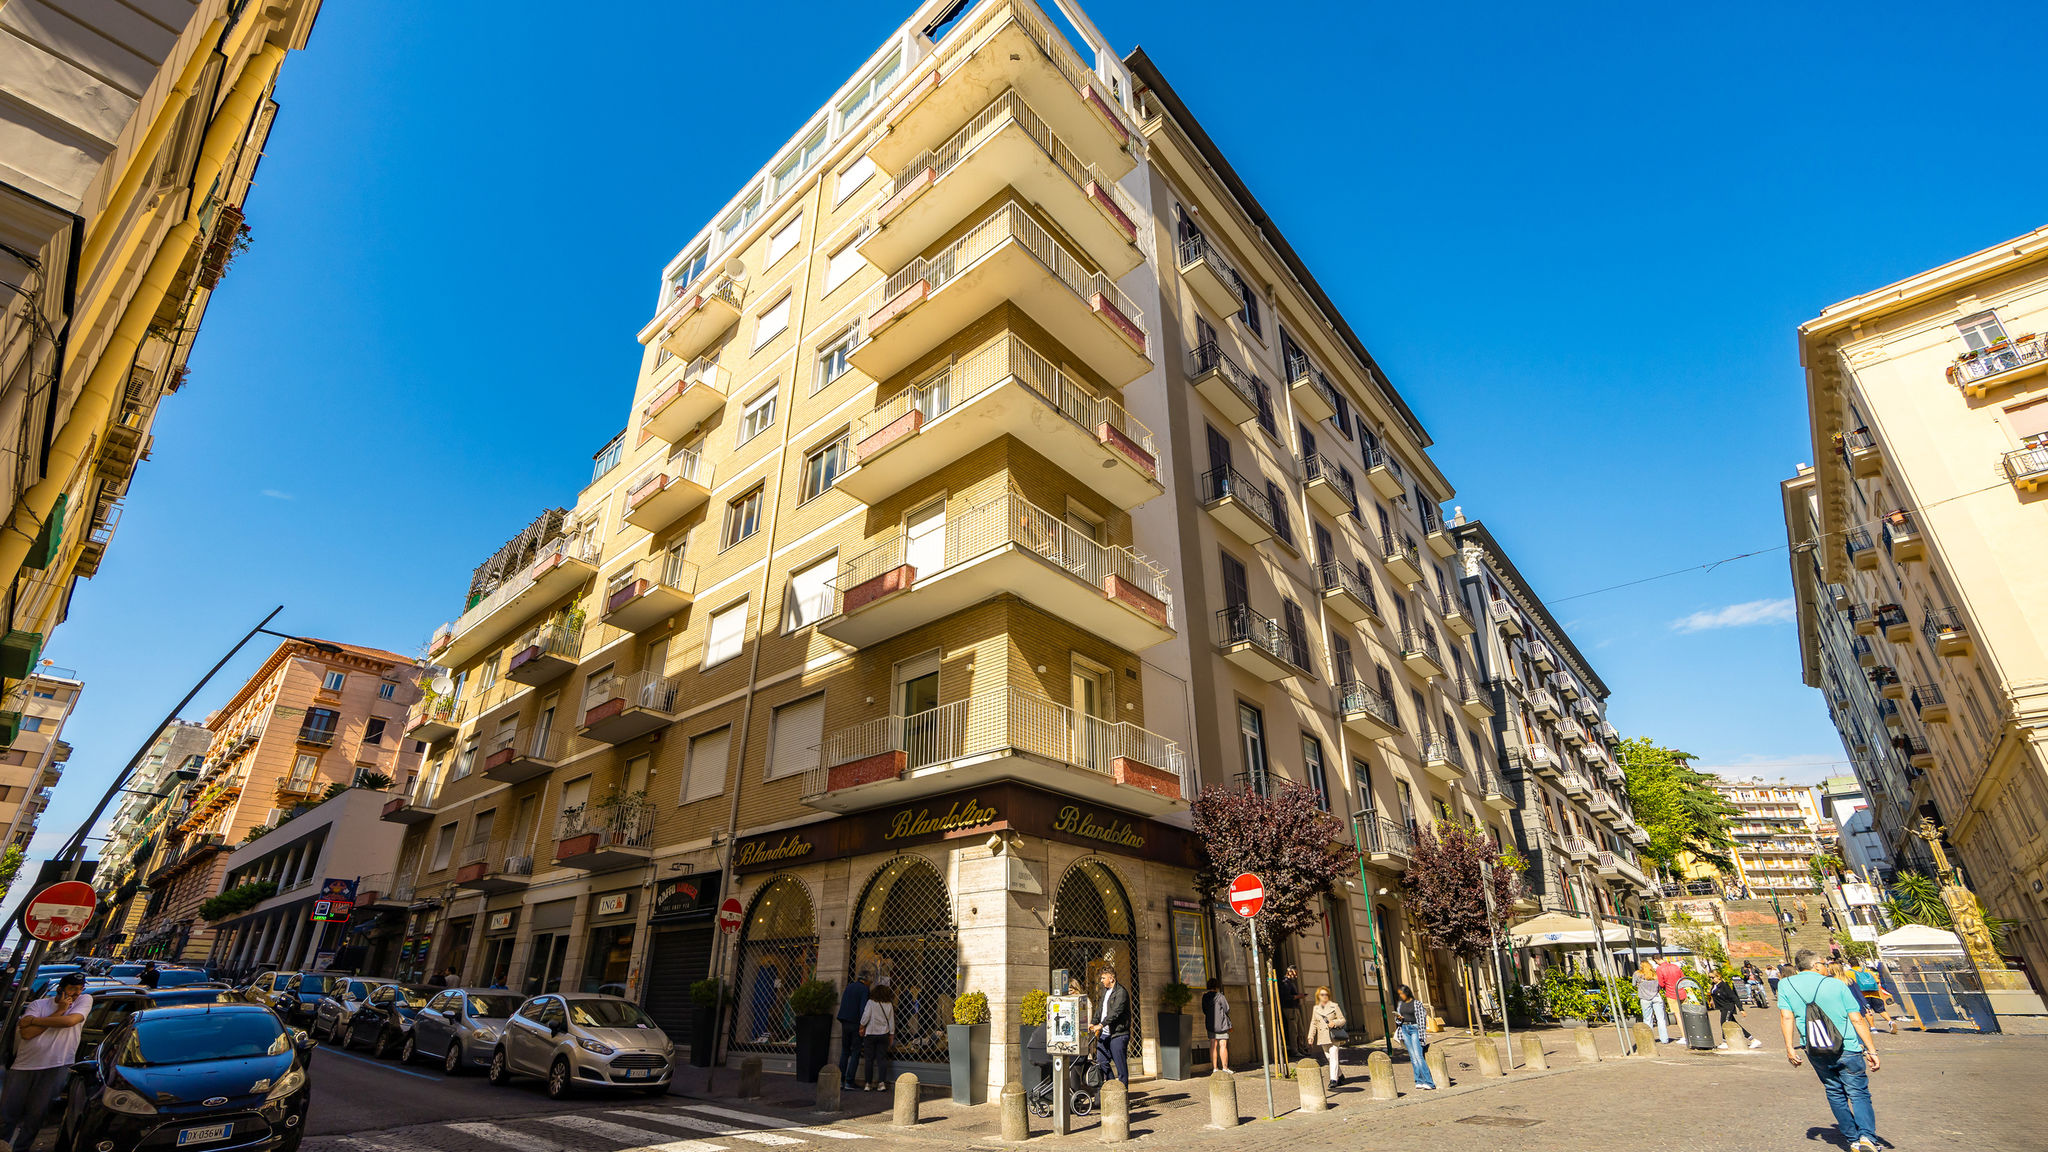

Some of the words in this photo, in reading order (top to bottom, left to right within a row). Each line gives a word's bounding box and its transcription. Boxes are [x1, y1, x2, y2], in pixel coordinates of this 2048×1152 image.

[884, 798, 998, 840] Blandolino
[1054, 805, 1146, 849] Blandolino
[734, 834, 812, 866] Blandolino
[601, 899, 616, 911] ING
[1062, 973, 1068, 989] P
